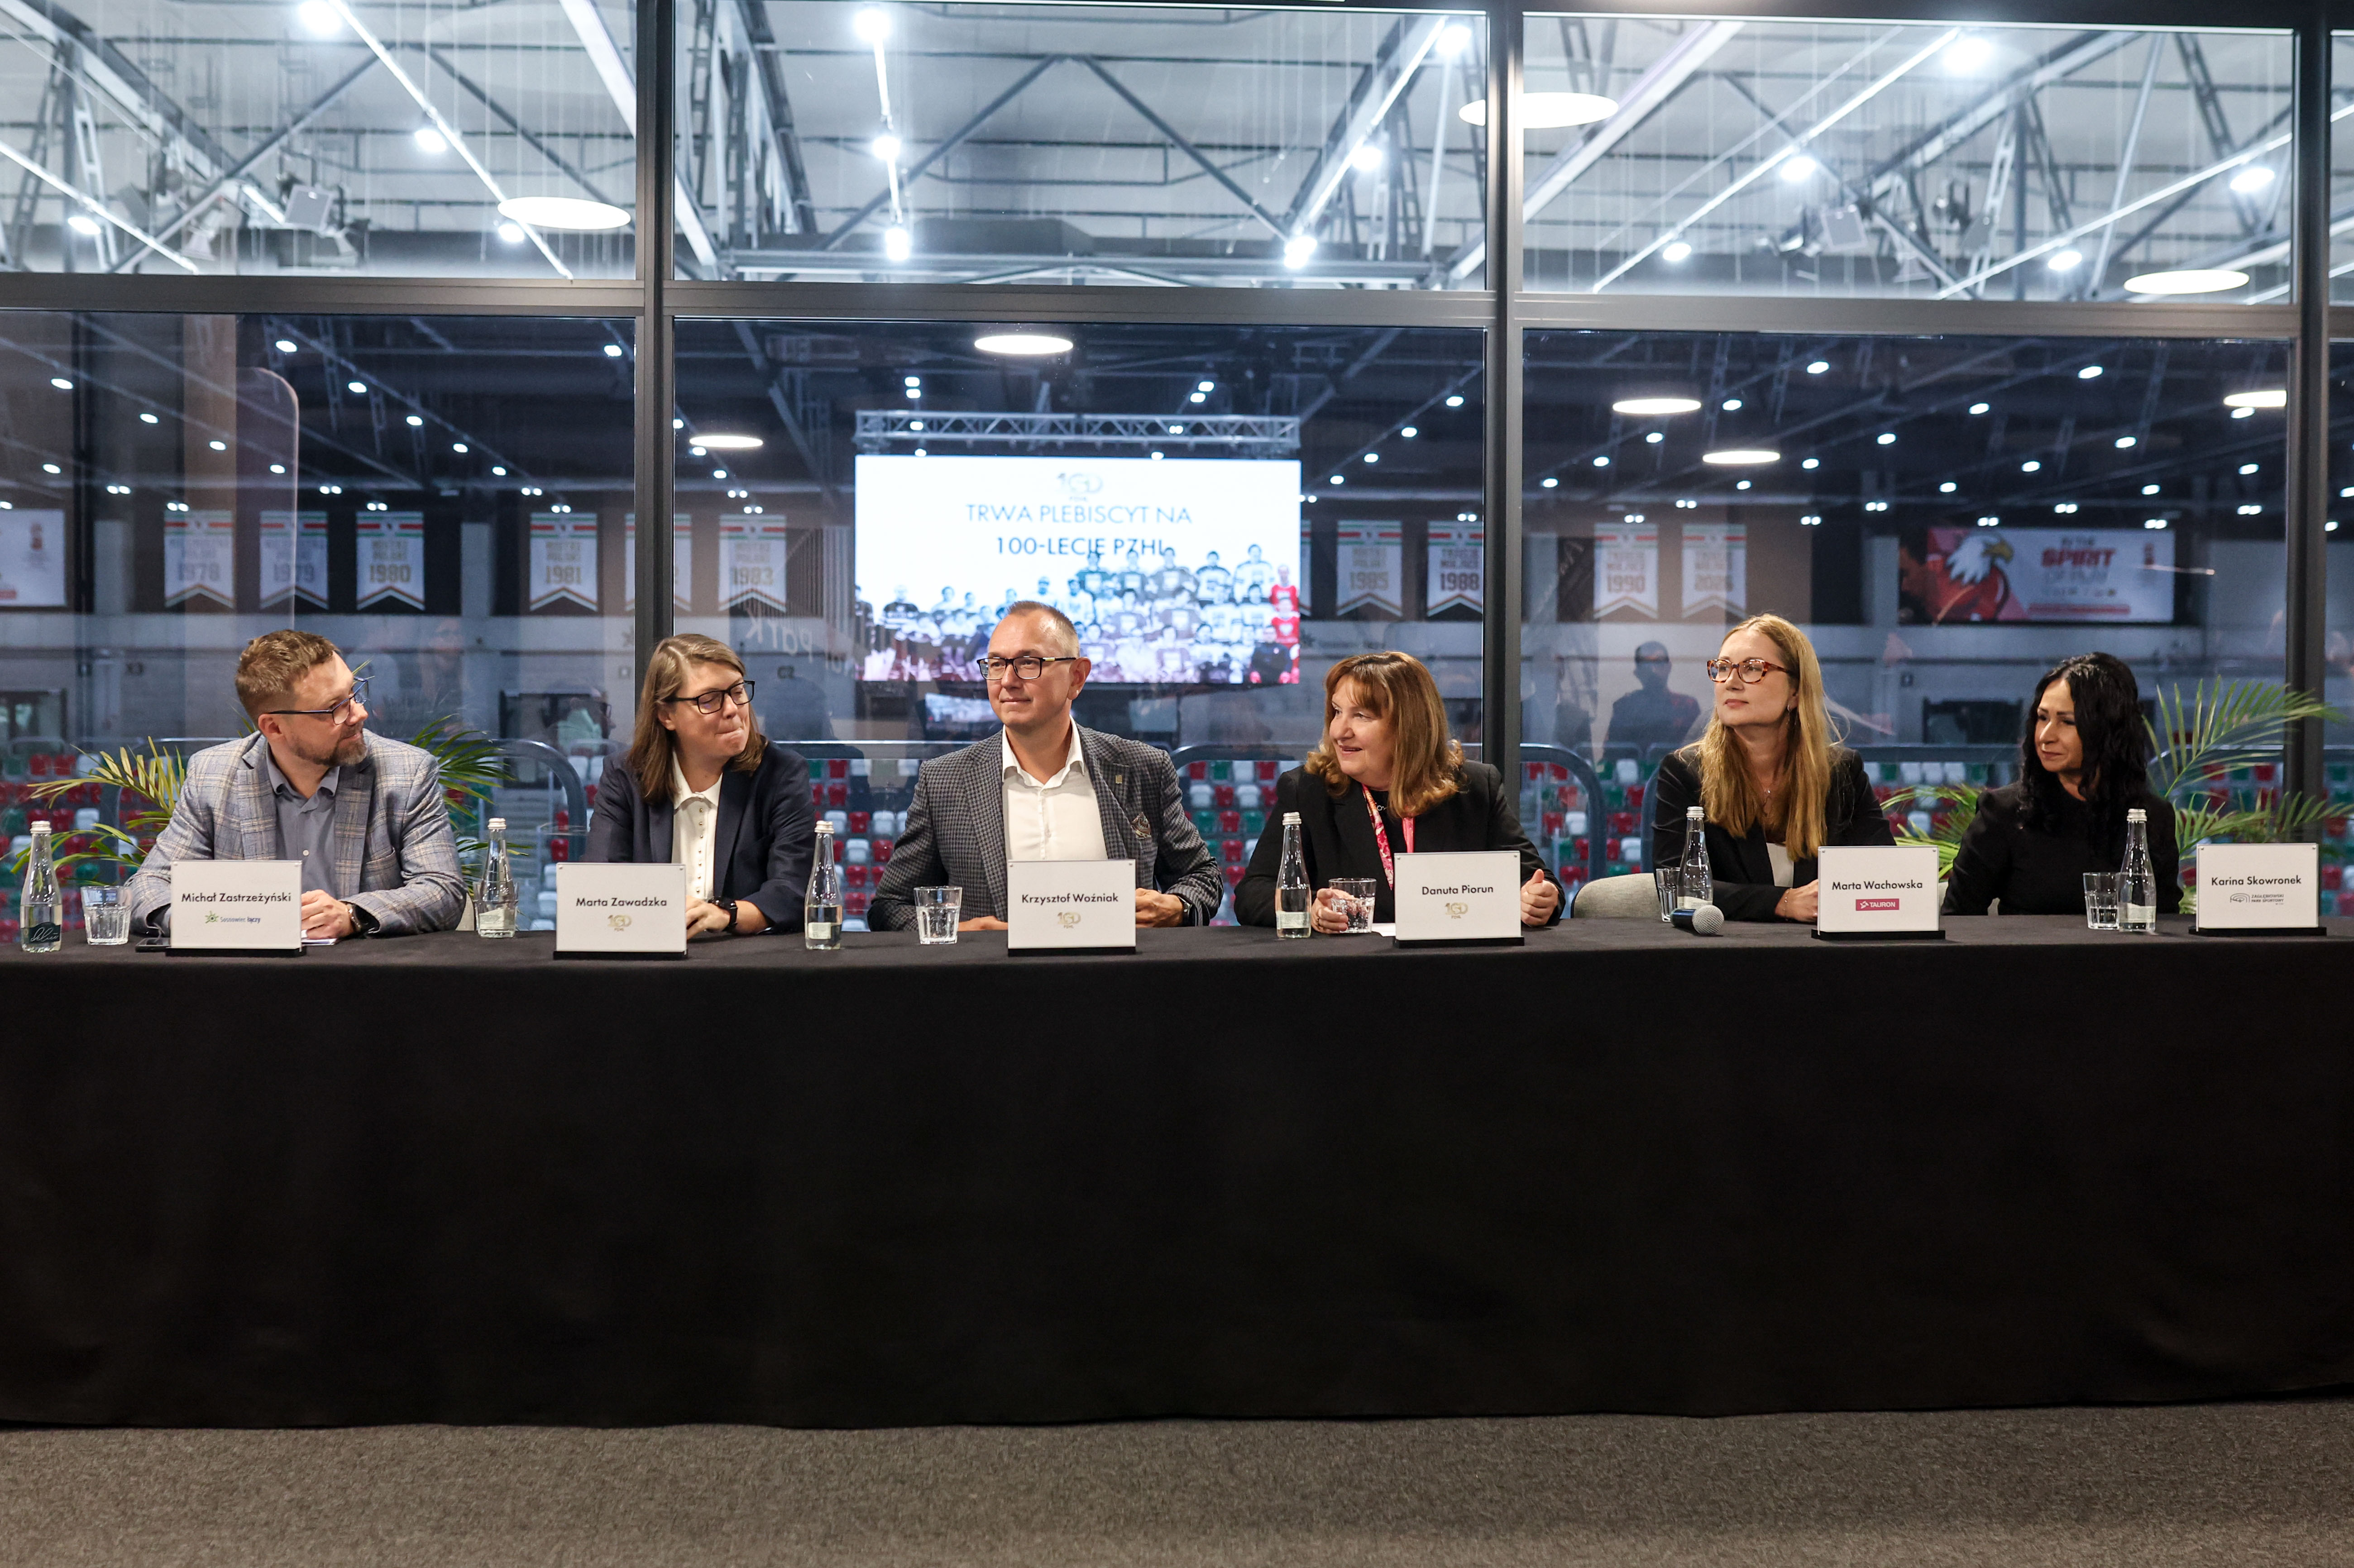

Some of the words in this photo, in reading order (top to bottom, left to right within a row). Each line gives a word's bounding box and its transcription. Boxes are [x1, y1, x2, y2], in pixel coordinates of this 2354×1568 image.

[966, 503, 1033, 522] TRWA
[1040, 506, 1149, 524] PLEBISCYT
[1156, 506, 1192, 524] NA
[997, 537, 1105, 555] 100-LECIE
[369, 564, 411, 583] 1980
[546, 566, 581, 584] 1981
[1440, 572, 1480, 591] 1988
[1832, 881, 1861, 890] Marta
[1863, 879, 1923, 889] Wachowska
[2211, 877, 2244, 886] Karina
[2247, 875, 2302, 885] Skowronek
[1422, 886, 1459, 895] Danuta
[1462, 884, 1493, 894] Piorun
[181, 892, 216, 902] Michał
[219, 892, 291, 904] Zastrzeżyński
[576, 897, 608, 907] Marta
[611, 897, 667, 906] Zawadzka
[1022, 893, 1071, 906] Krzysztof
[1072, 893, 1119, 903] Woźniak
